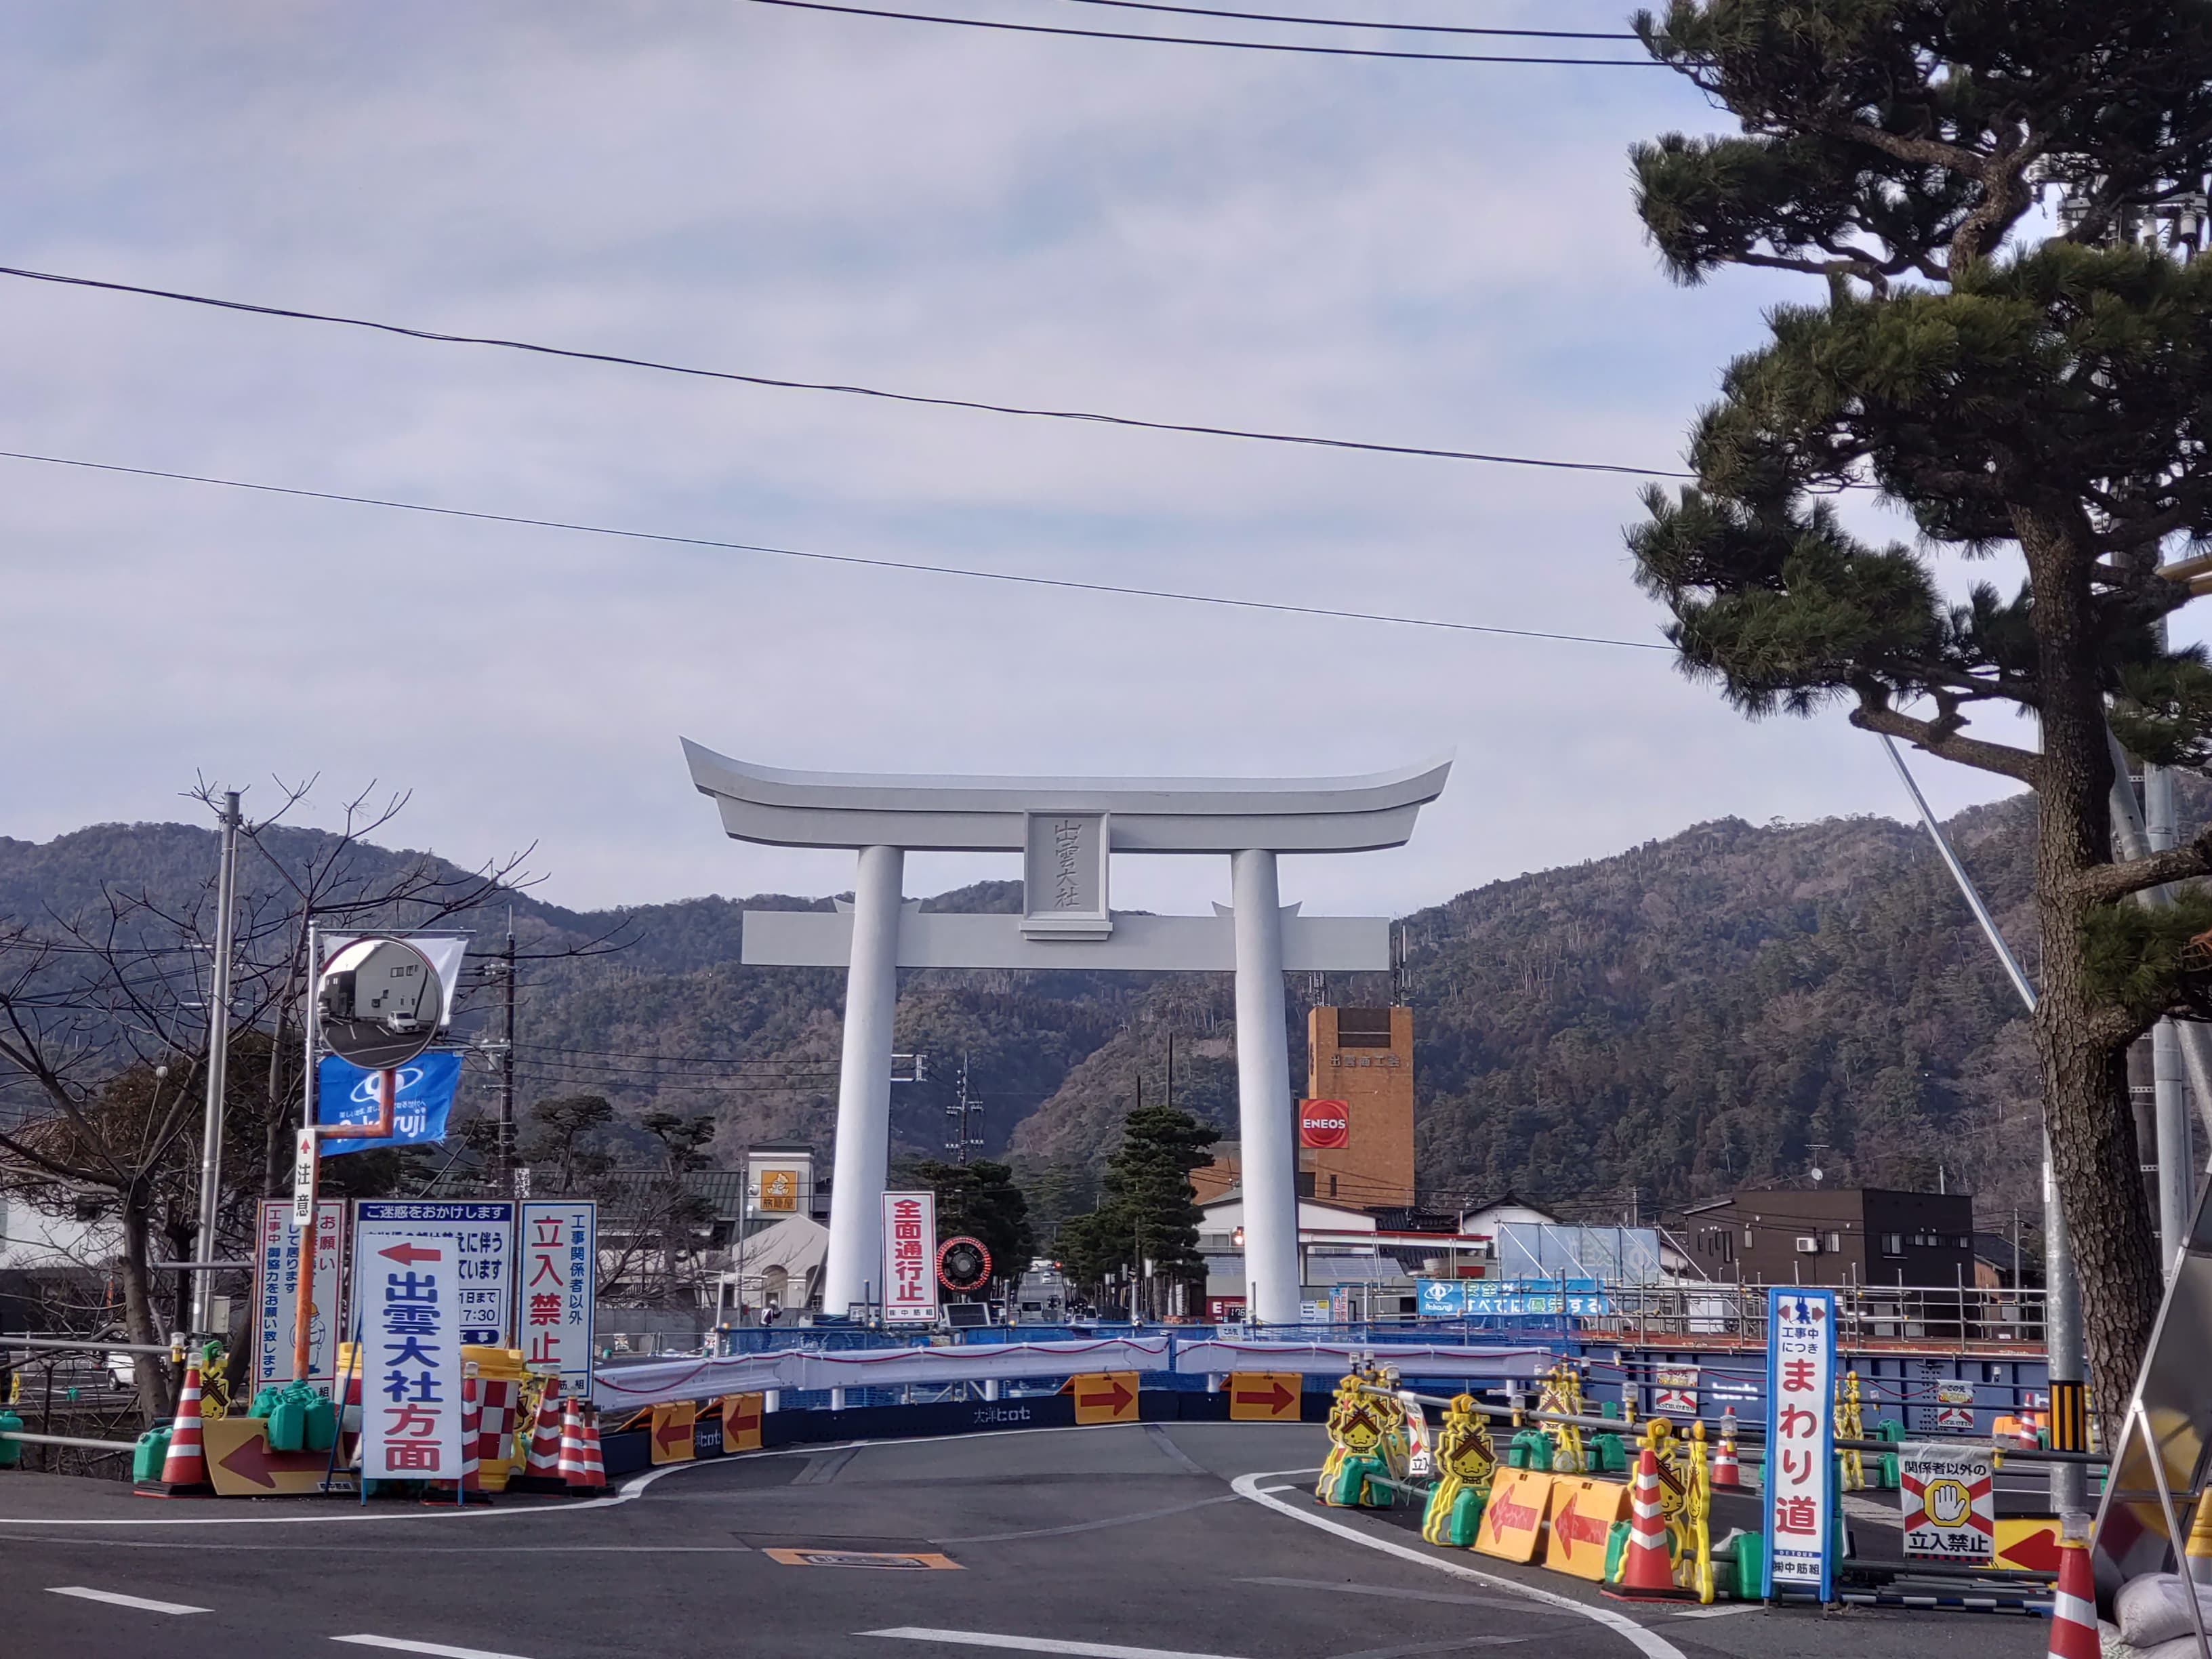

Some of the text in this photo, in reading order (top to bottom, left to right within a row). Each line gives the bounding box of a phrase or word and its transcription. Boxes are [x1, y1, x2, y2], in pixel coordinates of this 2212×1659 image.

[1054, 819, 1082, 908] 出雲大社
[1303, 1118, 1346, 1129] ENEOS
[295, 1162, 311, 1217] 注意
[366, 1205, 505, 1219] ご迷惑をおかけします
[320, 1214, 336, 1271] お願い
[568, 1214, 586, 1325] 工事関係者以外
[893, 1199, 925, 1301] 全面通行止
[527, 1215, 565, 1364] 立入禁止
[1782, 1327, 1819, 1340] 工事中
[1782, 1342, 1819, 1355] につき
[382, 1271, 444, 1472] 出雲大社方面
[1775, 1357, 1818, 1536] まわり道
[1904, 1460, 1987, 1476] 関係者以外の
[1908, 1531, 1990, 1553] 立入禁止
